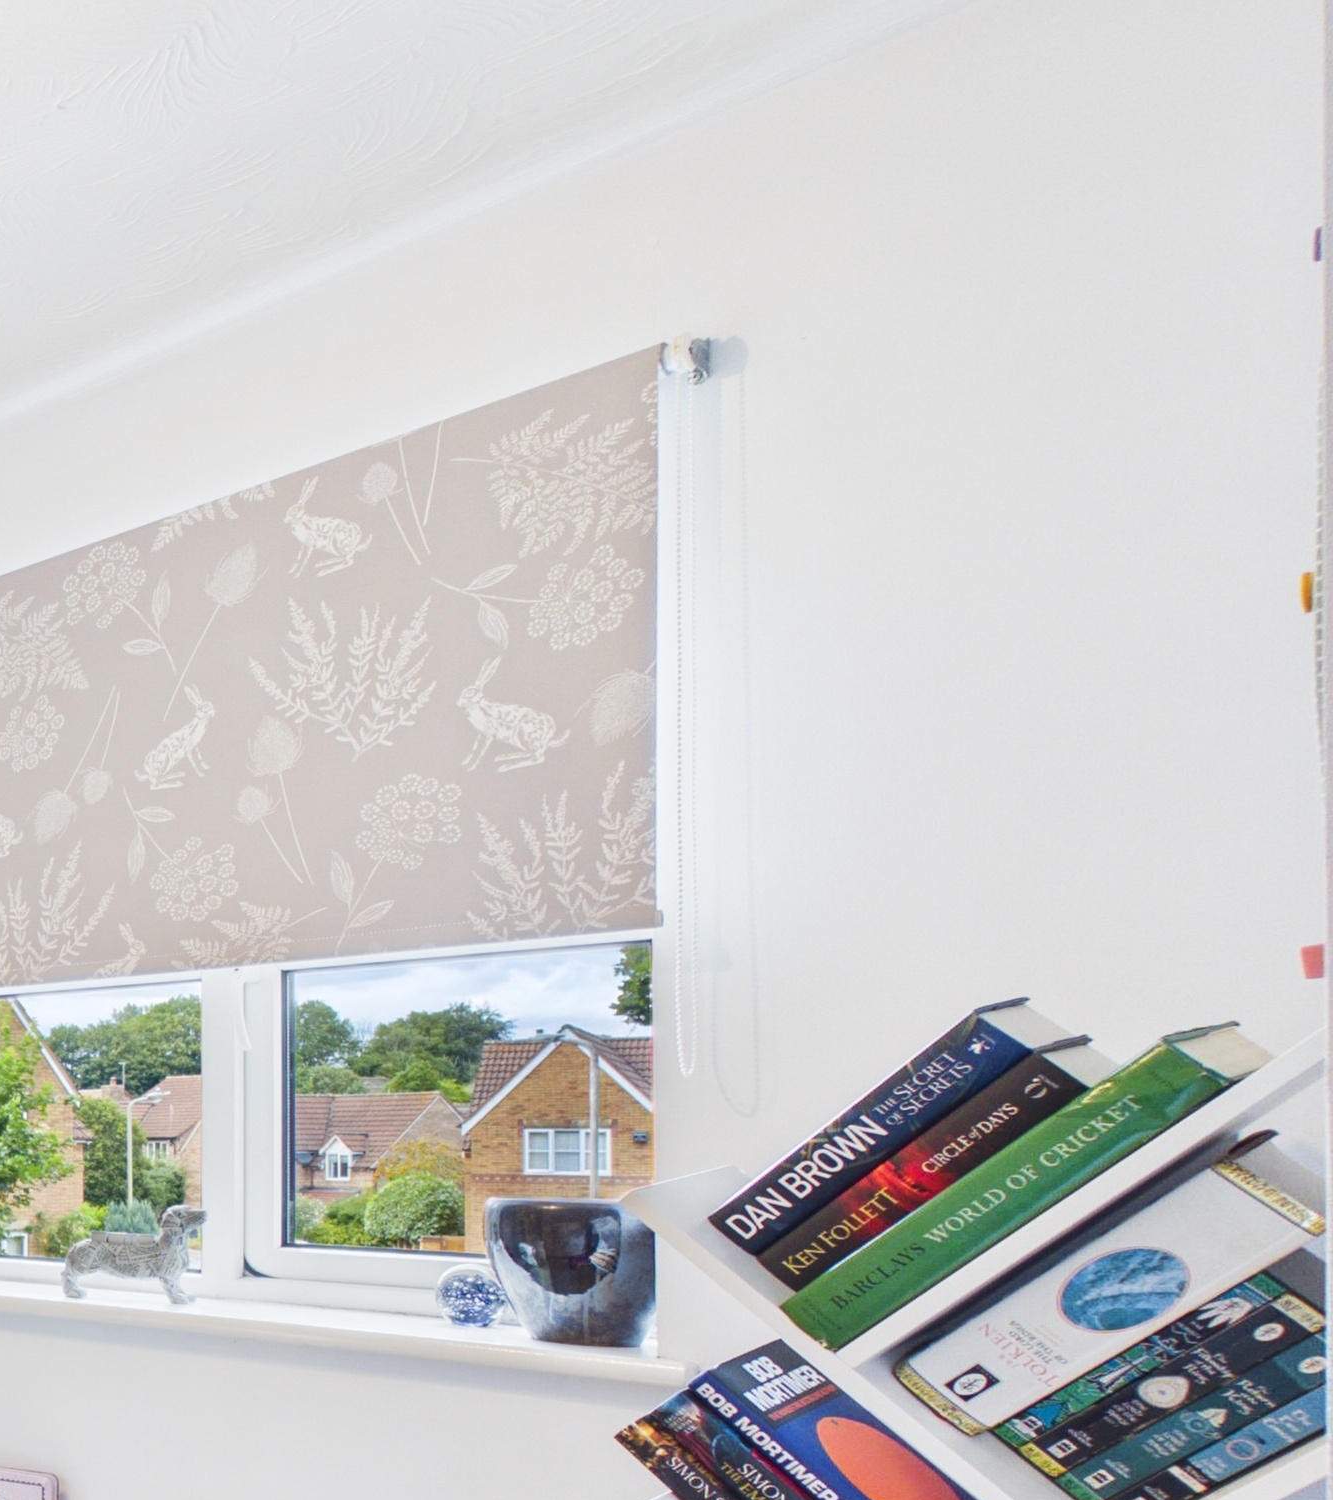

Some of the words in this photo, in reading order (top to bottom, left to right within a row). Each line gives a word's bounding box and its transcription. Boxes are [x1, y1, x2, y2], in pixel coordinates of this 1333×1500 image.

[873, 1096, 898, 1116] THE
[892, 1051, 957, 1100] SECRET
[885, 1111, 904, 1126] OF
[899, 1061, 974, 1116] SECRETS
[921, 1134, 975, 1174] CIRCLE
[976, 1102, 1019, 1134] DAYS
[725, 1188, 793, 1240] DAN
[778, 1115, 889, 1199] BROWN
[830, 1242, 927, 1311] BARCLAYS
[923, 1188, 1007, 1245] WORLD
[1005, 1165, 1039, 1191] OF
[1039, 1094, 1145, 1169] CRICKET
[781, 1242, 827, 1276] KEN
[819, 1186, 900, 1249] FOLLETT
[741, 1356, 783, 1383] BOB
[978, 1322, 1058, 1388] TOLKIEN
[696, 1383, 738, 1419] BOB
[744, 1364, 826, 1413] MORTIMER
[666, 1456, 717, 1499] SIMON
[721, 1461, 741, 1486] THE
